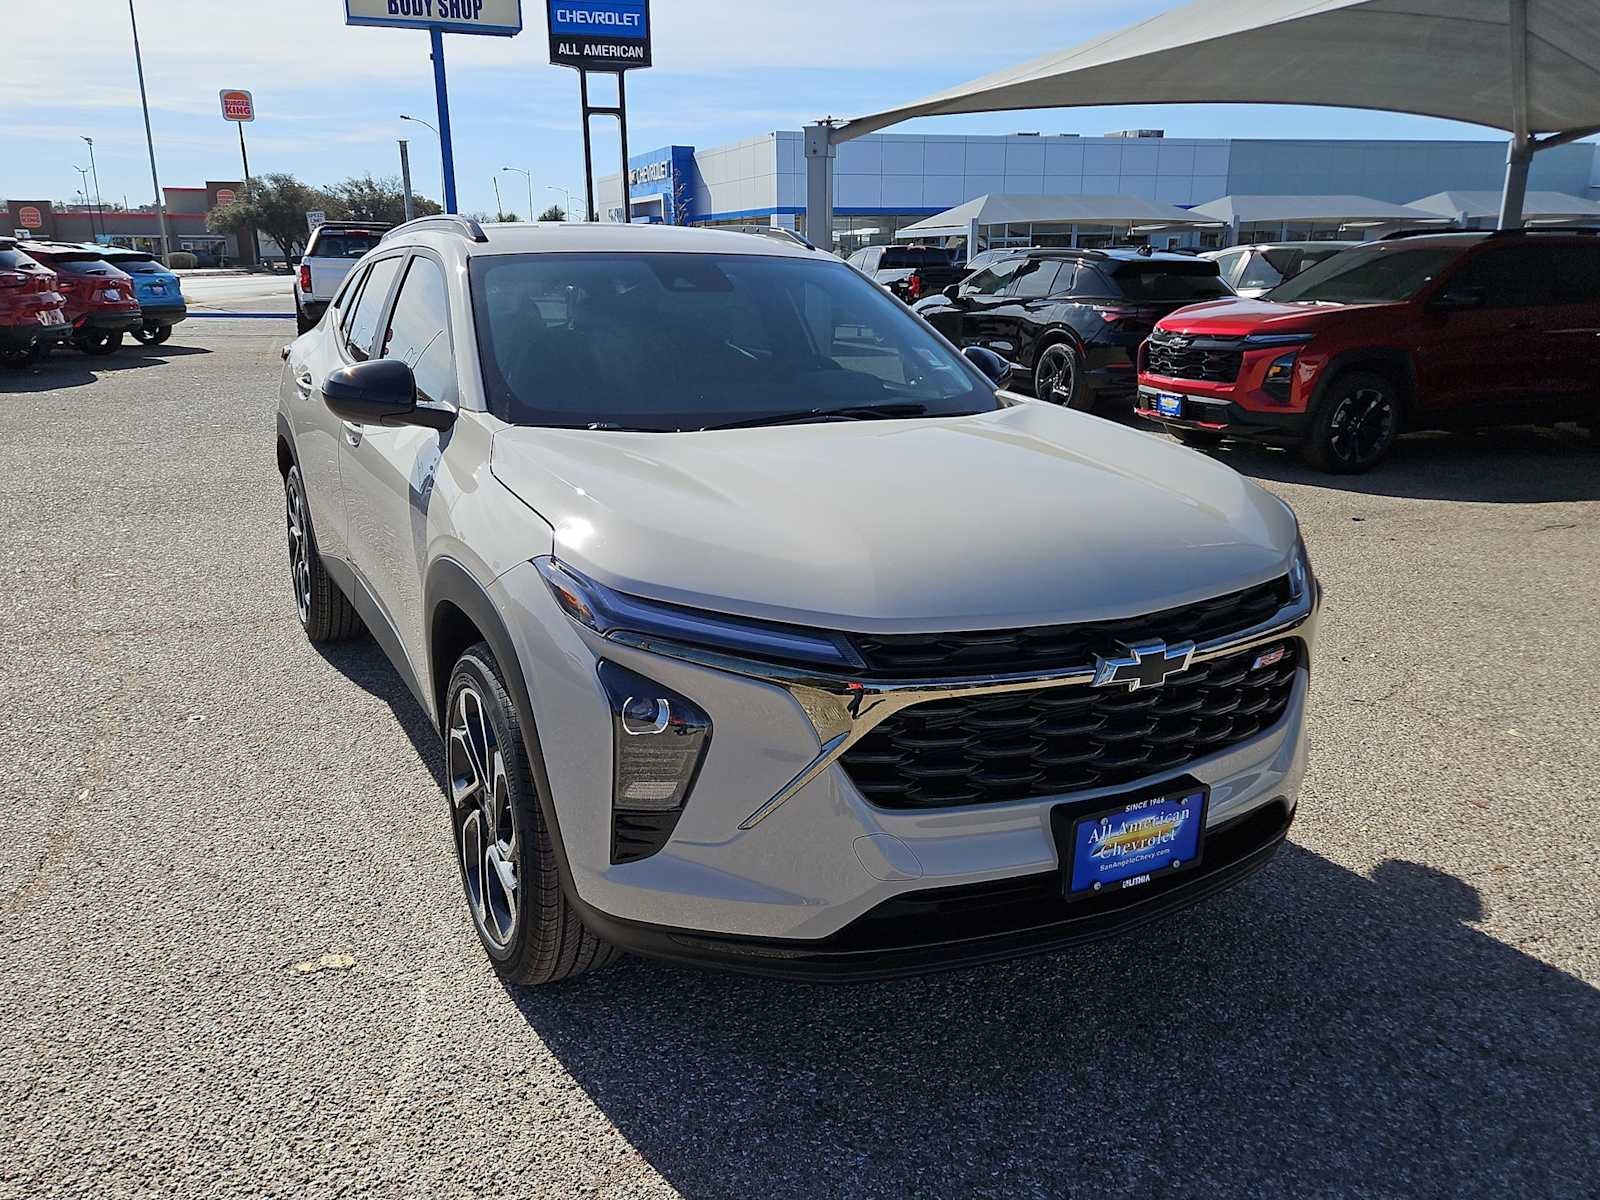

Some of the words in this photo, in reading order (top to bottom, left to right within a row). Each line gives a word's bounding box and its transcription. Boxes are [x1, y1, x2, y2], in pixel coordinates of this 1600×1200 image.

[388, 0, 433, 17] BODY
[438, 0, 483, 20] SHOP
[556, 9, 641, 26] CHEVROLET
[558, 42, 580, 56] ALL
[583, 44, 644, 58] AMERICAN
[225, 106, 251, 115] KING
[1125, 800, 1148, 813] SINCE
[1087, 823, 1113, 844] All
[1119, 808, 1190, 835] American
[1100, 828, 1176, 859] Chevrolet
[1099, 847, 1171, 872] SanAngeloChevy.com
